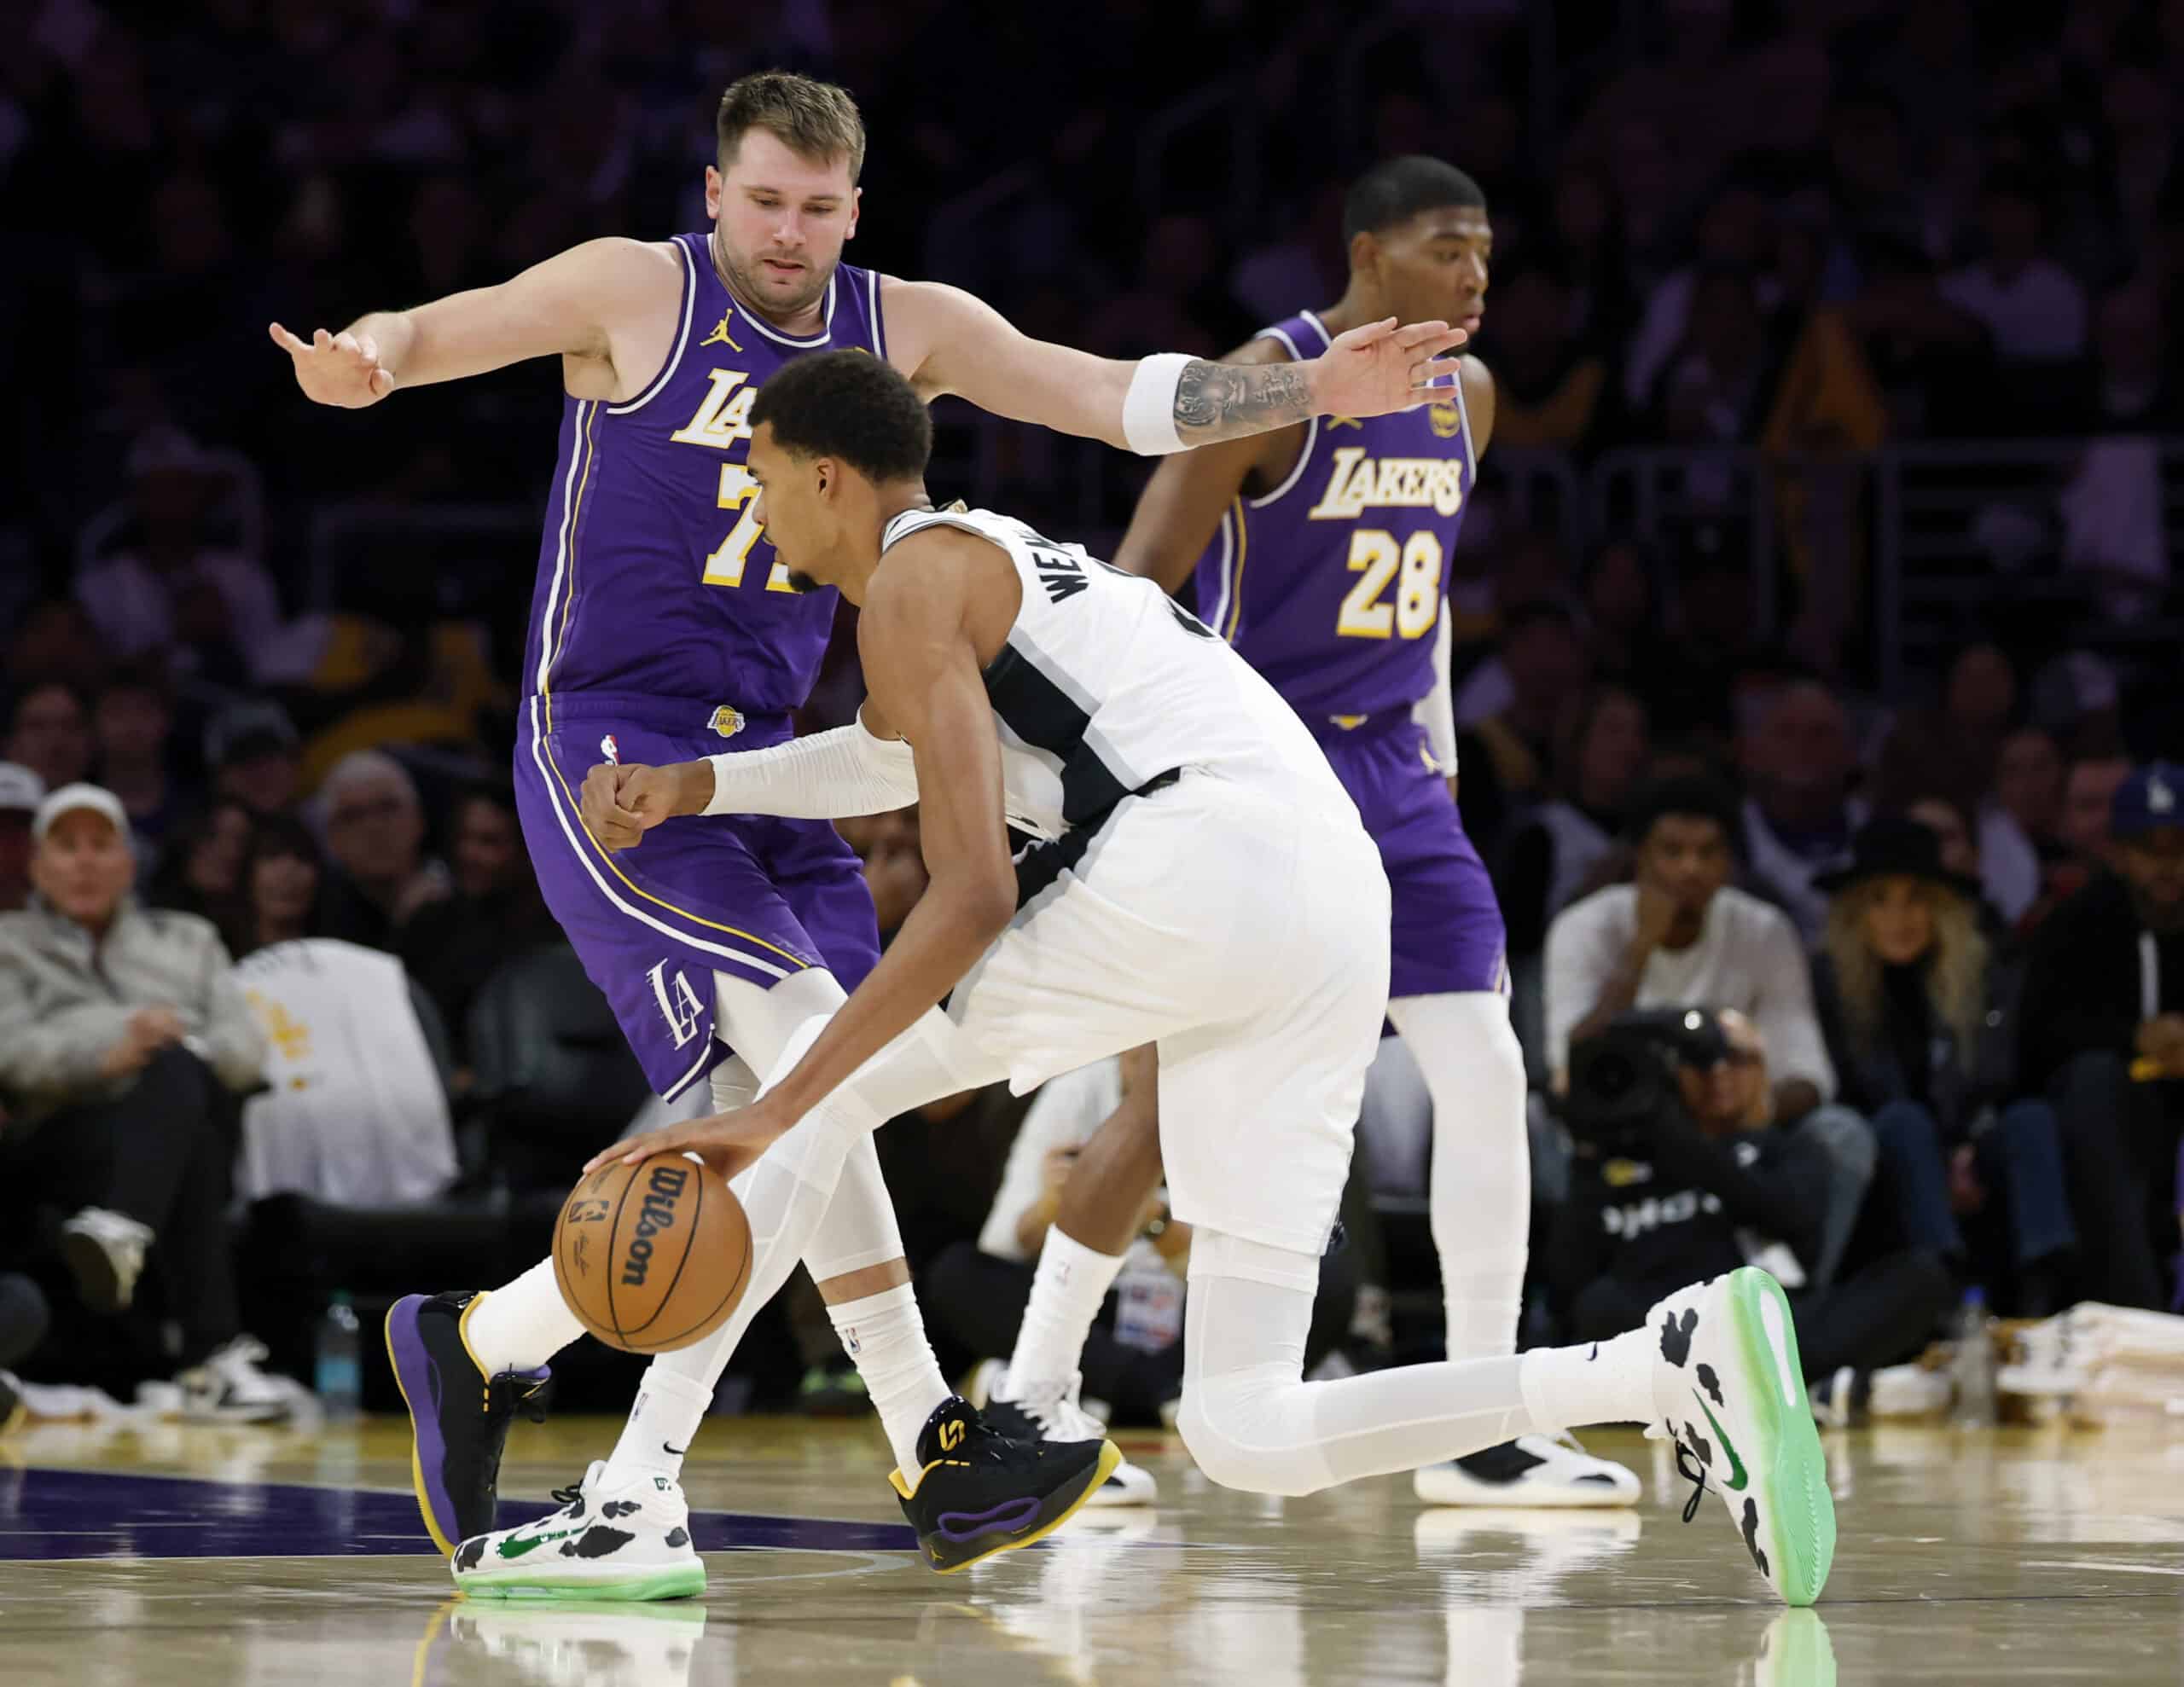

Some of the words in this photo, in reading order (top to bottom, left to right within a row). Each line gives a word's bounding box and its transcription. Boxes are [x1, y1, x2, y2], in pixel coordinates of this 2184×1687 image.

[702, 462, 804, 594] 7
[1307, 446, 1462, 519] LAKERS
[1337, 528, 1443, 639] 28
[646, 957, 705, 1052] LA
[622, 1166, 688, 1286] Wilson
